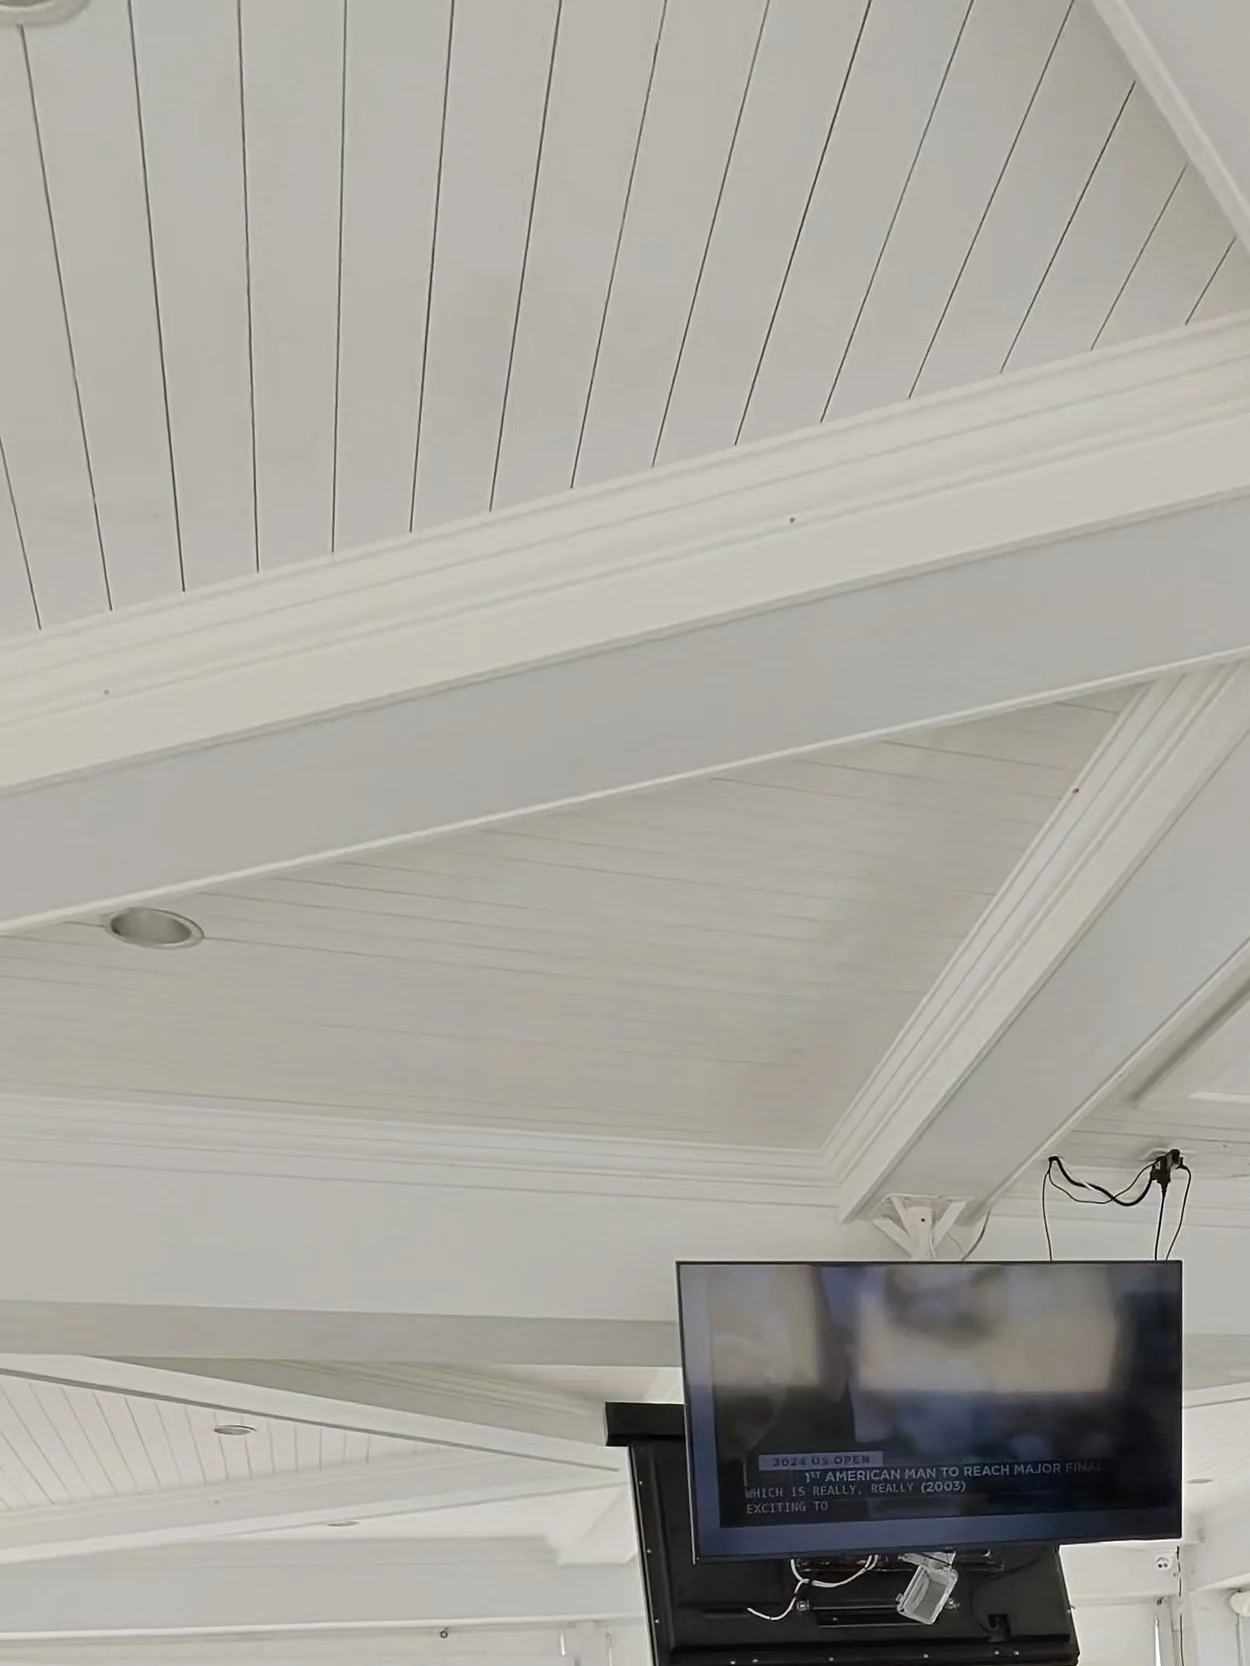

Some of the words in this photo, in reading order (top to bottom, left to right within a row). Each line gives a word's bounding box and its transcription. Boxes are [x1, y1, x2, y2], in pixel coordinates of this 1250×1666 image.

[773, 1457, 806, 1468] 2024
[811, 1455, 829, 1466] US
[833, 1453, 871, 1465] OPEN
[824, 1469, 901, 1483] AMERICAN
[903, 1467, 937, 1480] MAN
[939, 1466, 960, 1478] TO
[964, 1464, 1011, 1477] REACH
[1014, 1462, 1061, 1476] MAJOR
[1065, 1461, 1106, 1473] FINAL
[743, 1488, 784, 1500] WHICH
[791, 1487, 807, 1498] IS
[871, 1482, 915, 1494] REALLY
[919, 1480, 968, 1495] (2003)
[745, 1501, 808, 1516] EXCITING
[813, 1500, 831, 1512] TO
